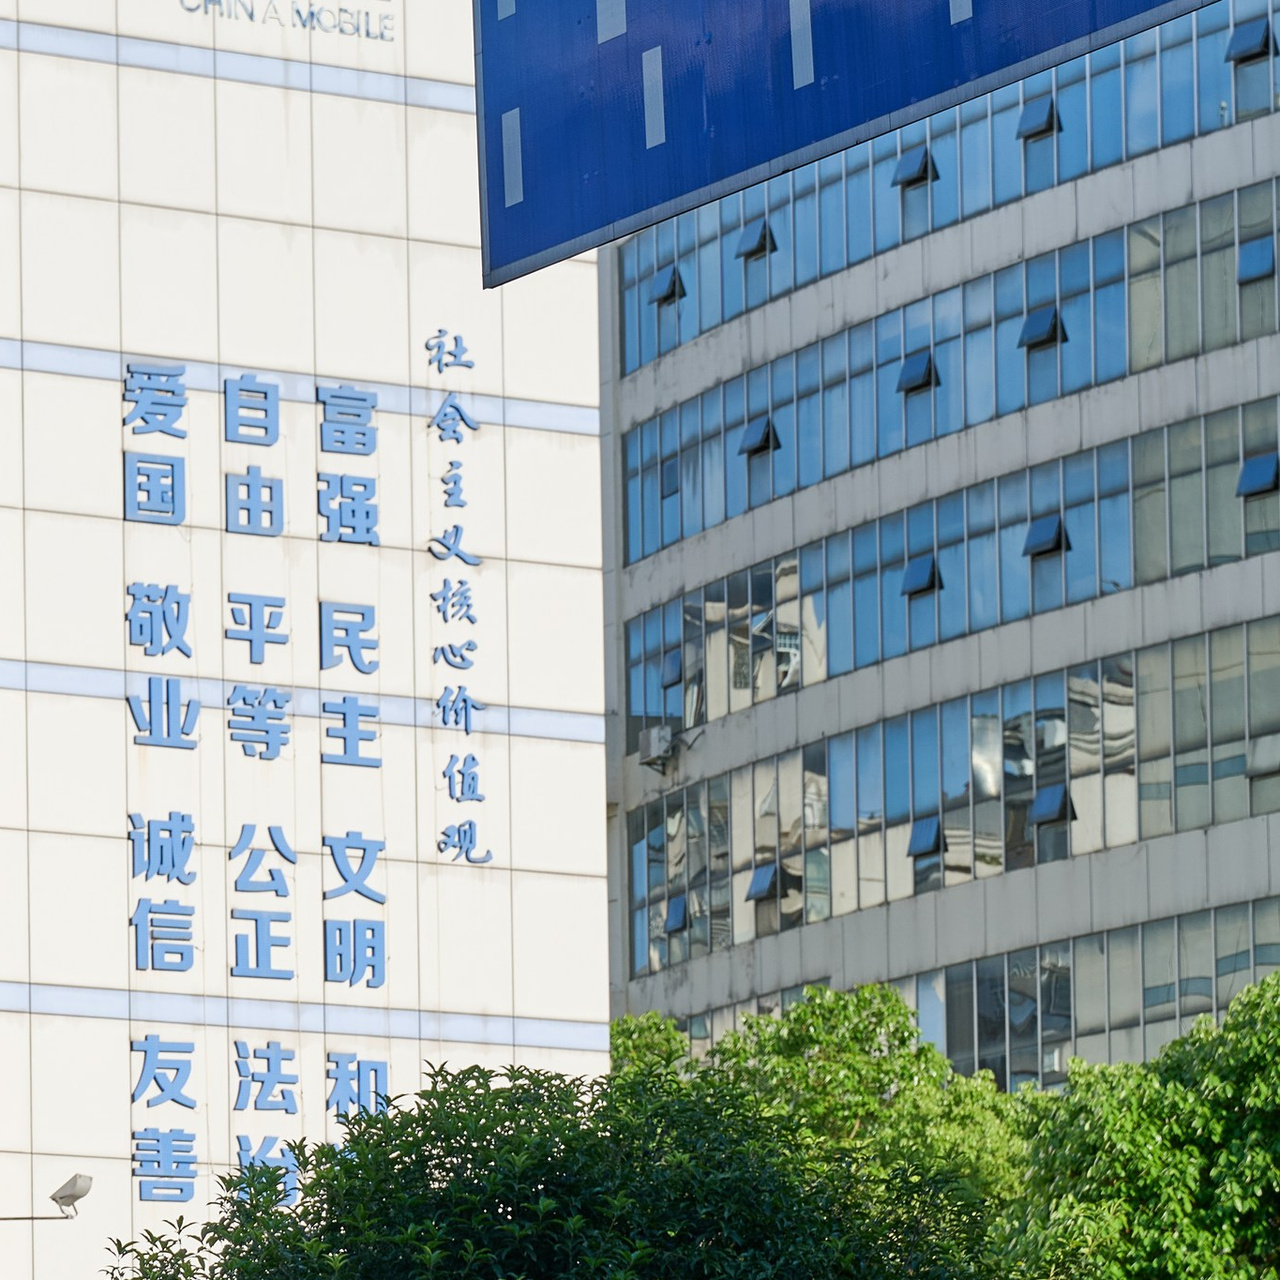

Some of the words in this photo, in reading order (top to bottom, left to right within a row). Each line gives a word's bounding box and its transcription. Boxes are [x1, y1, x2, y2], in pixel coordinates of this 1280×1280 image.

[292, 1, 395, 42] MOBILE
[122, 363, 189, 526] 爱国
[224, 373, 285, 539] 自由
[317, 384, 382, 546] 富强
[125, 581, 200, 751] 敬业
[226, 592, 291, 762] 平等
[425, 328, 493, 864] 社会主义核心价值观
[320, 601, 384, 769] 民主
[128, 811, 198, 973] 诚信
[228, 823, 298, 982] 公正
[323, 830, 387, 989] 文明
[130, 1034, 198, 1202] 友善
[234, 1040, 299, 1206] 法治
[327, 1052, 388, 1150] 和
